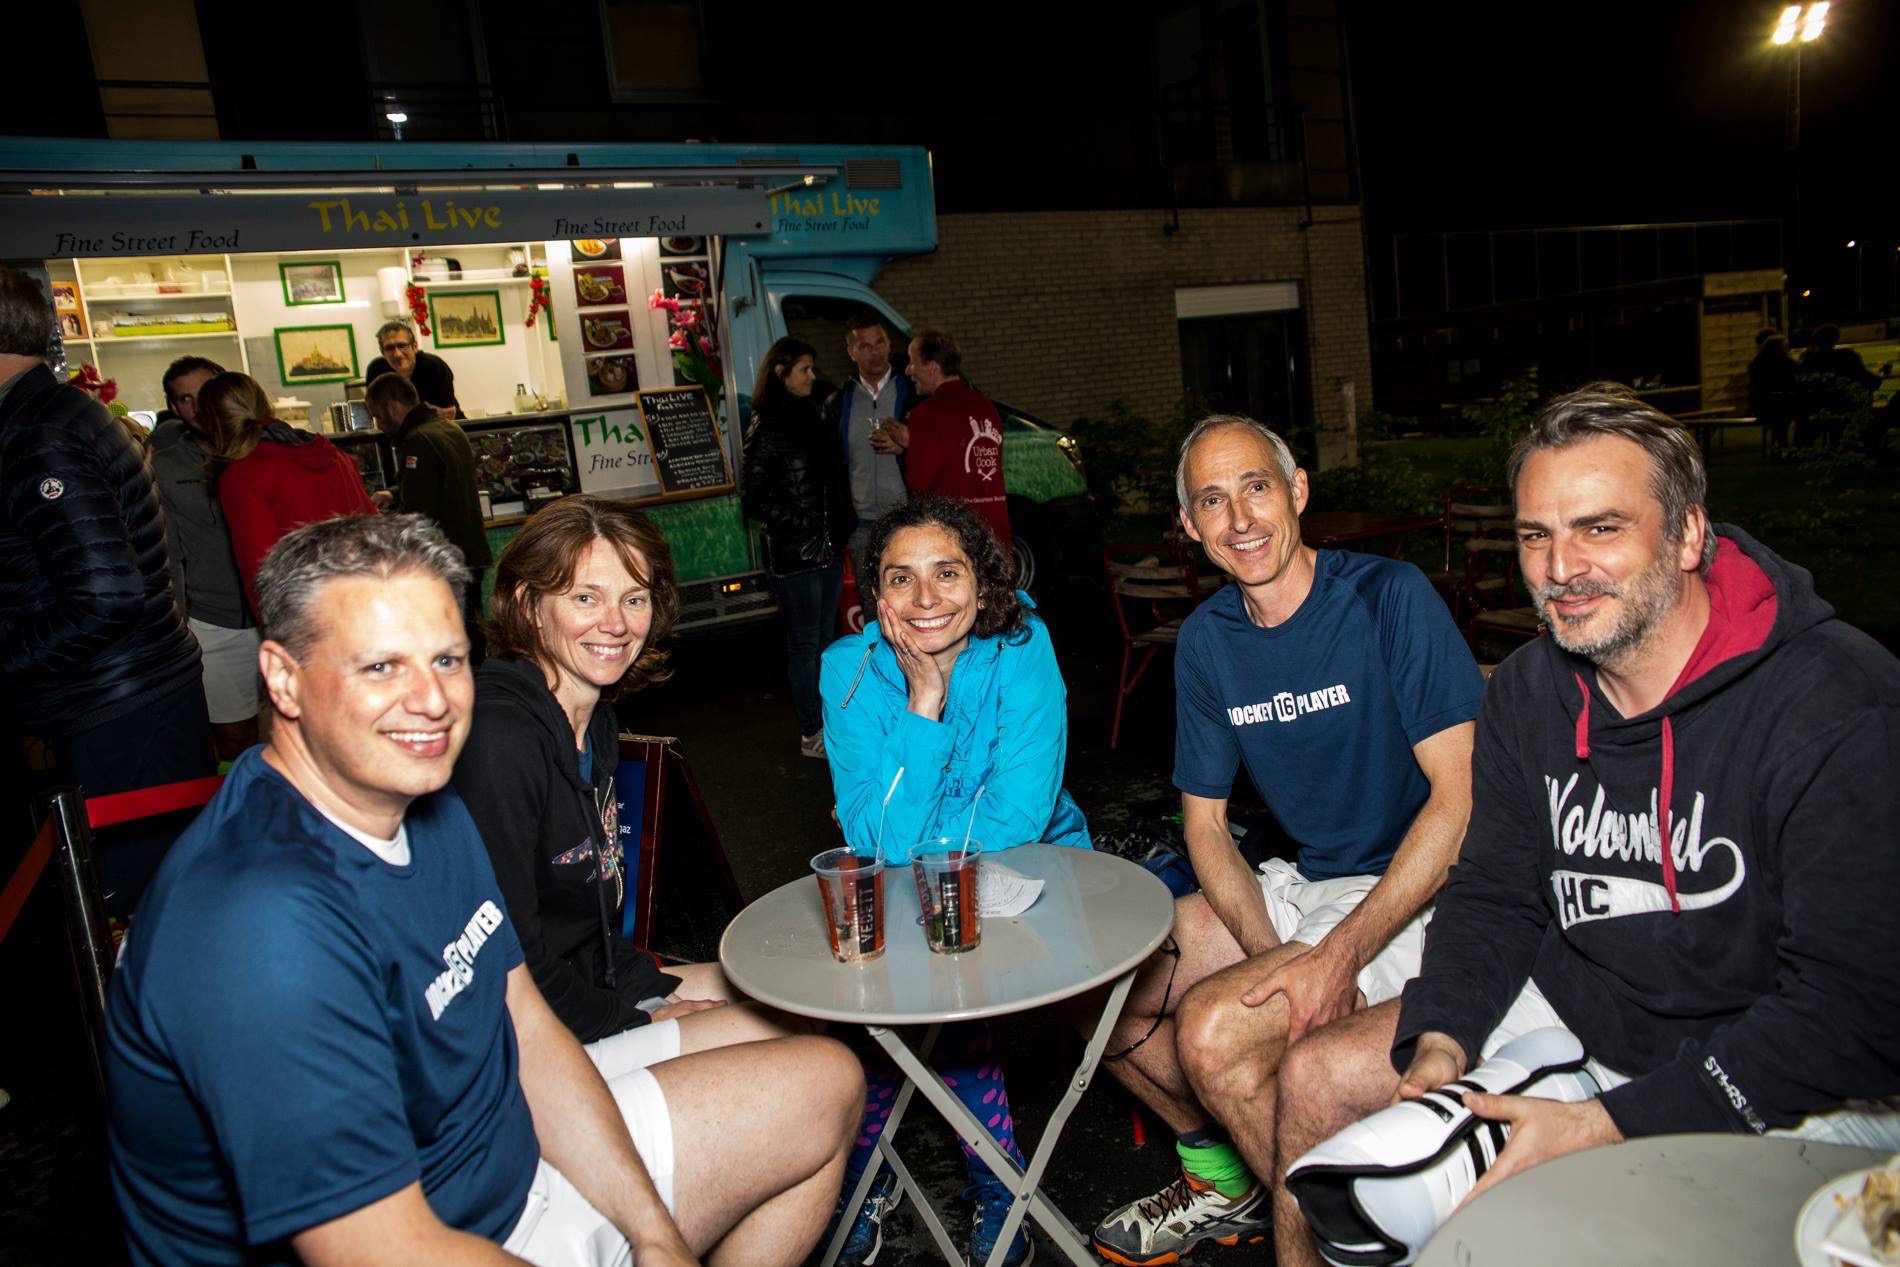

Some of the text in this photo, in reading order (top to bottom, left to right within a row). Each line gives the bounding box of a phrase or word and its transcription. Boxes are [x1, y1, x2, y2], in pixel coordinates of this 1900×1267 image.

[308, 198, 504, 233] Thai Live
[768, 190, 880, 217] Thai Live
[552, 214, 686, 238] Fine Street Food
[776, 216, 869, 234] Fine Street Food
[52, 229, 240, 256] Fine Street Food
[573, 414, 645, 447] Tha
[588, 453, 622, 474] Fine
[627, 449, 655, 467] Str
[972, 446, 999, 457] Urban
[976, 456, 998, 468] Cook
[1276, 696, 1295, 718] 16
[1296, 684, 1351, 715] PLAYER
[1561, 876, 1610, 925] HC
[456, 900, 504, 965] PLAYER
